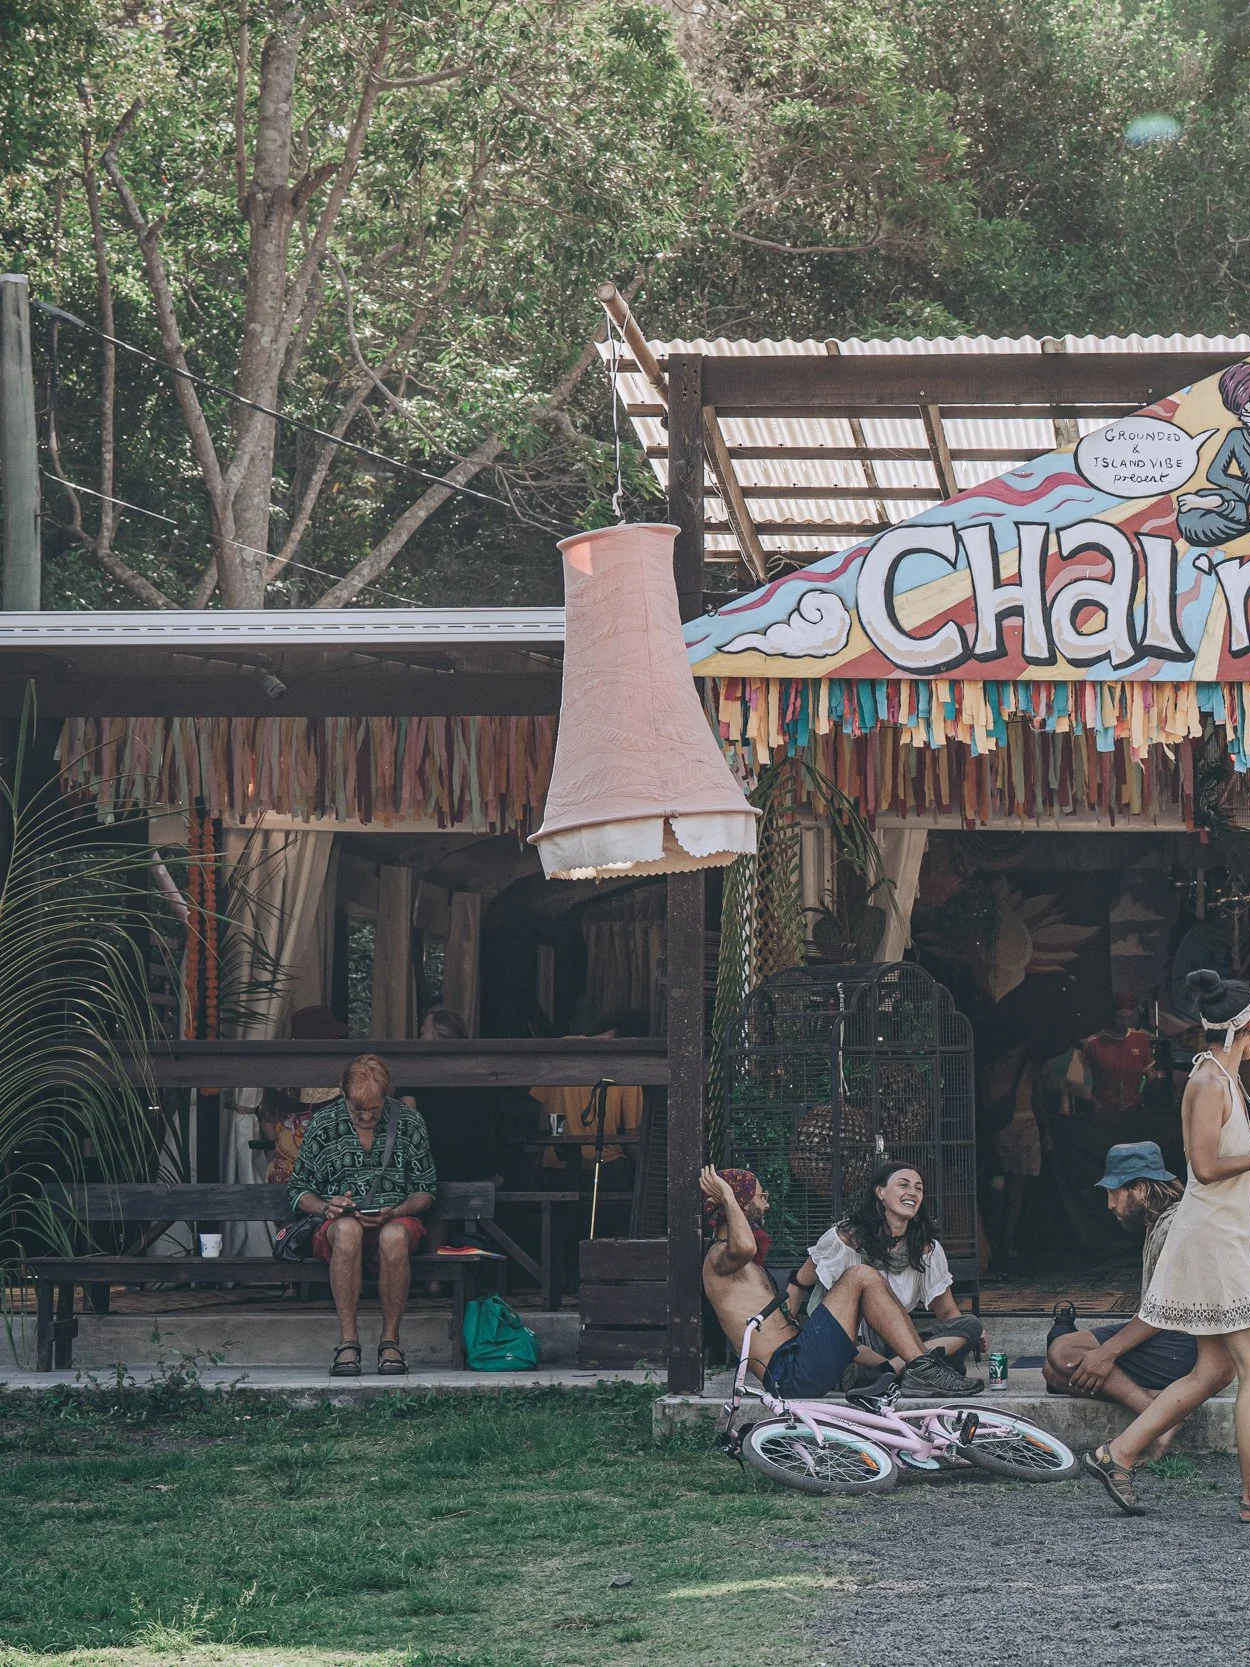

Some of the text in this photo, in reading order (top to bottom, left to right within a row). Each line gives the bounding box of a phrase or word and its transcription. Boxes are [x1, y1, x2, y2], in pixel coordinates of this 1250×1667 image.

[1104, 428, 1181, 442] GROUNDED
[1132, 444, 1141, 453] &
[1093, 456, 1183, 469] ISLAND VIBE
